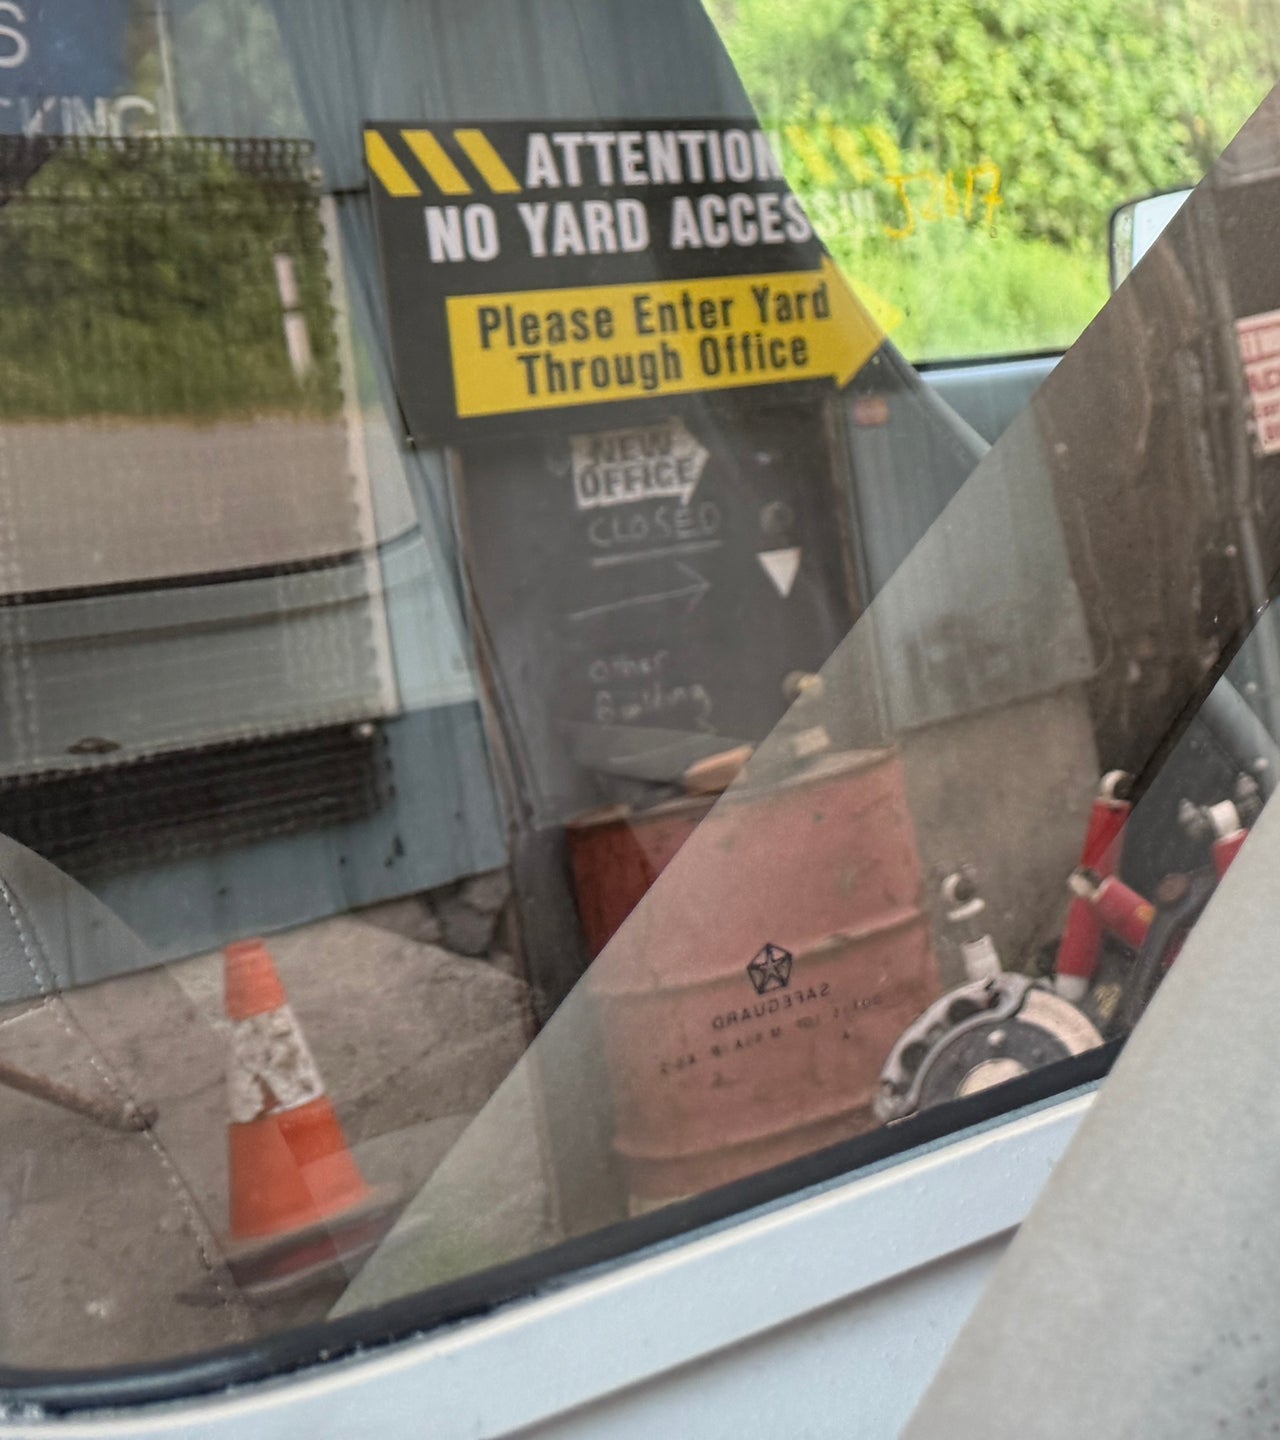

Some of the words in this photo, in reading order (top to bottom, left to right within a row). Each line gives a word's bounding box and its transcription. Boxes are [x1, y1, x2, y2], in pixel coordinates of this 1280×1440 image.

[526, 129, 785, 189] ATTENTION
[424, 203, 500, 263] NO
[517, 198, 650, 258] YARD
[477, 303, 615, 351] Please
[632, 291, 735, 336] Enter
[750, 281, 832, 324] Yard
[516, 341, 684, 397] Through
[698, 332, 808, 378] Office
[579, 456, 695, 499] OFFICE
[587, 500, 722, 547] CLOSED
